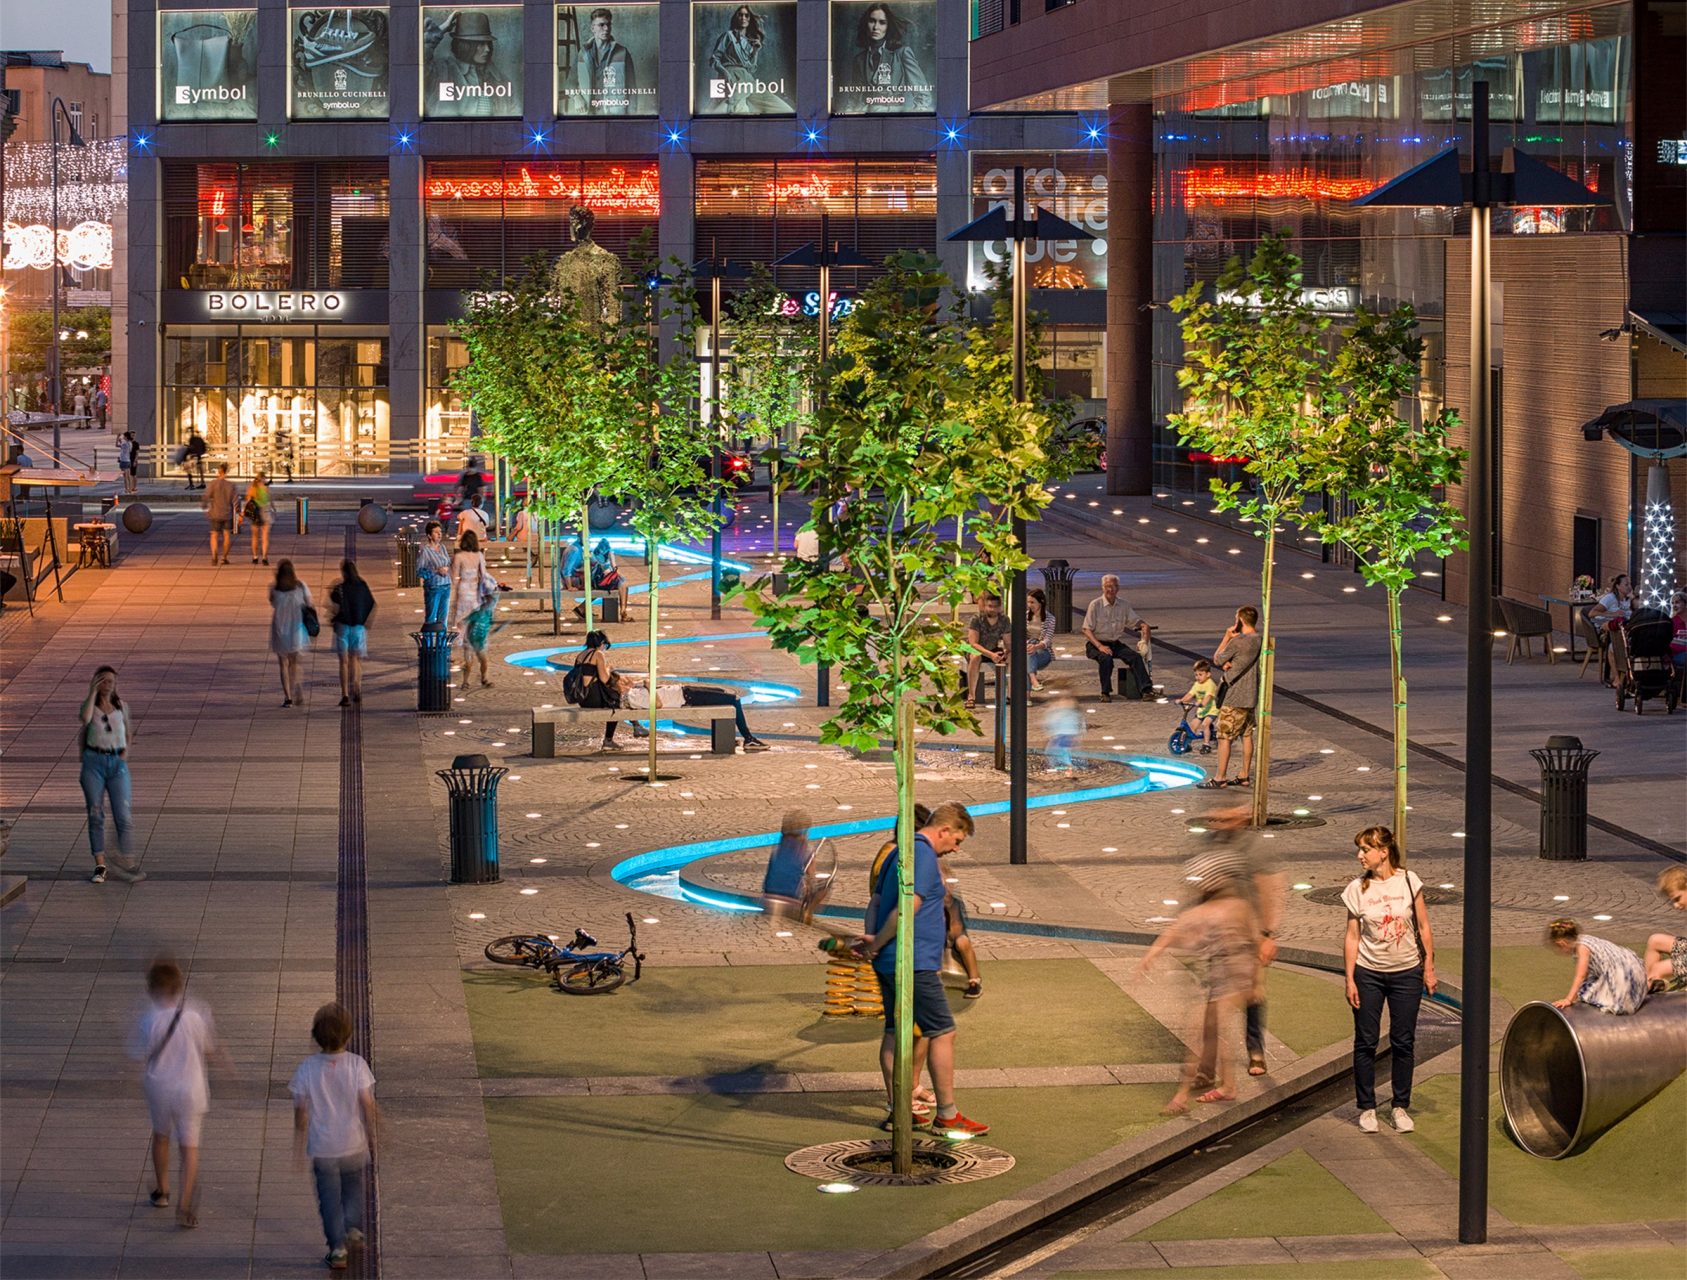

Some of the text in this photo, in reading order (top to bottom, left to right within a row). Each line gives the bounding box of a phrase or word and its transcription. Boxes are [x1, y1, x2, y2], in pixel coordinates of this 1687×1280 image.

[175, 85, 246, 104] symbol
[439, 82, 512, 101] symbol
[710, 78, 784, 98] symbol
[323, 101, 360, 110] symbol.ua
[591, 99, 629, 107] symbol.ua
[866, 95, 905, 104] symbol.ua
[209, 294, 340, 310] BOLERO
